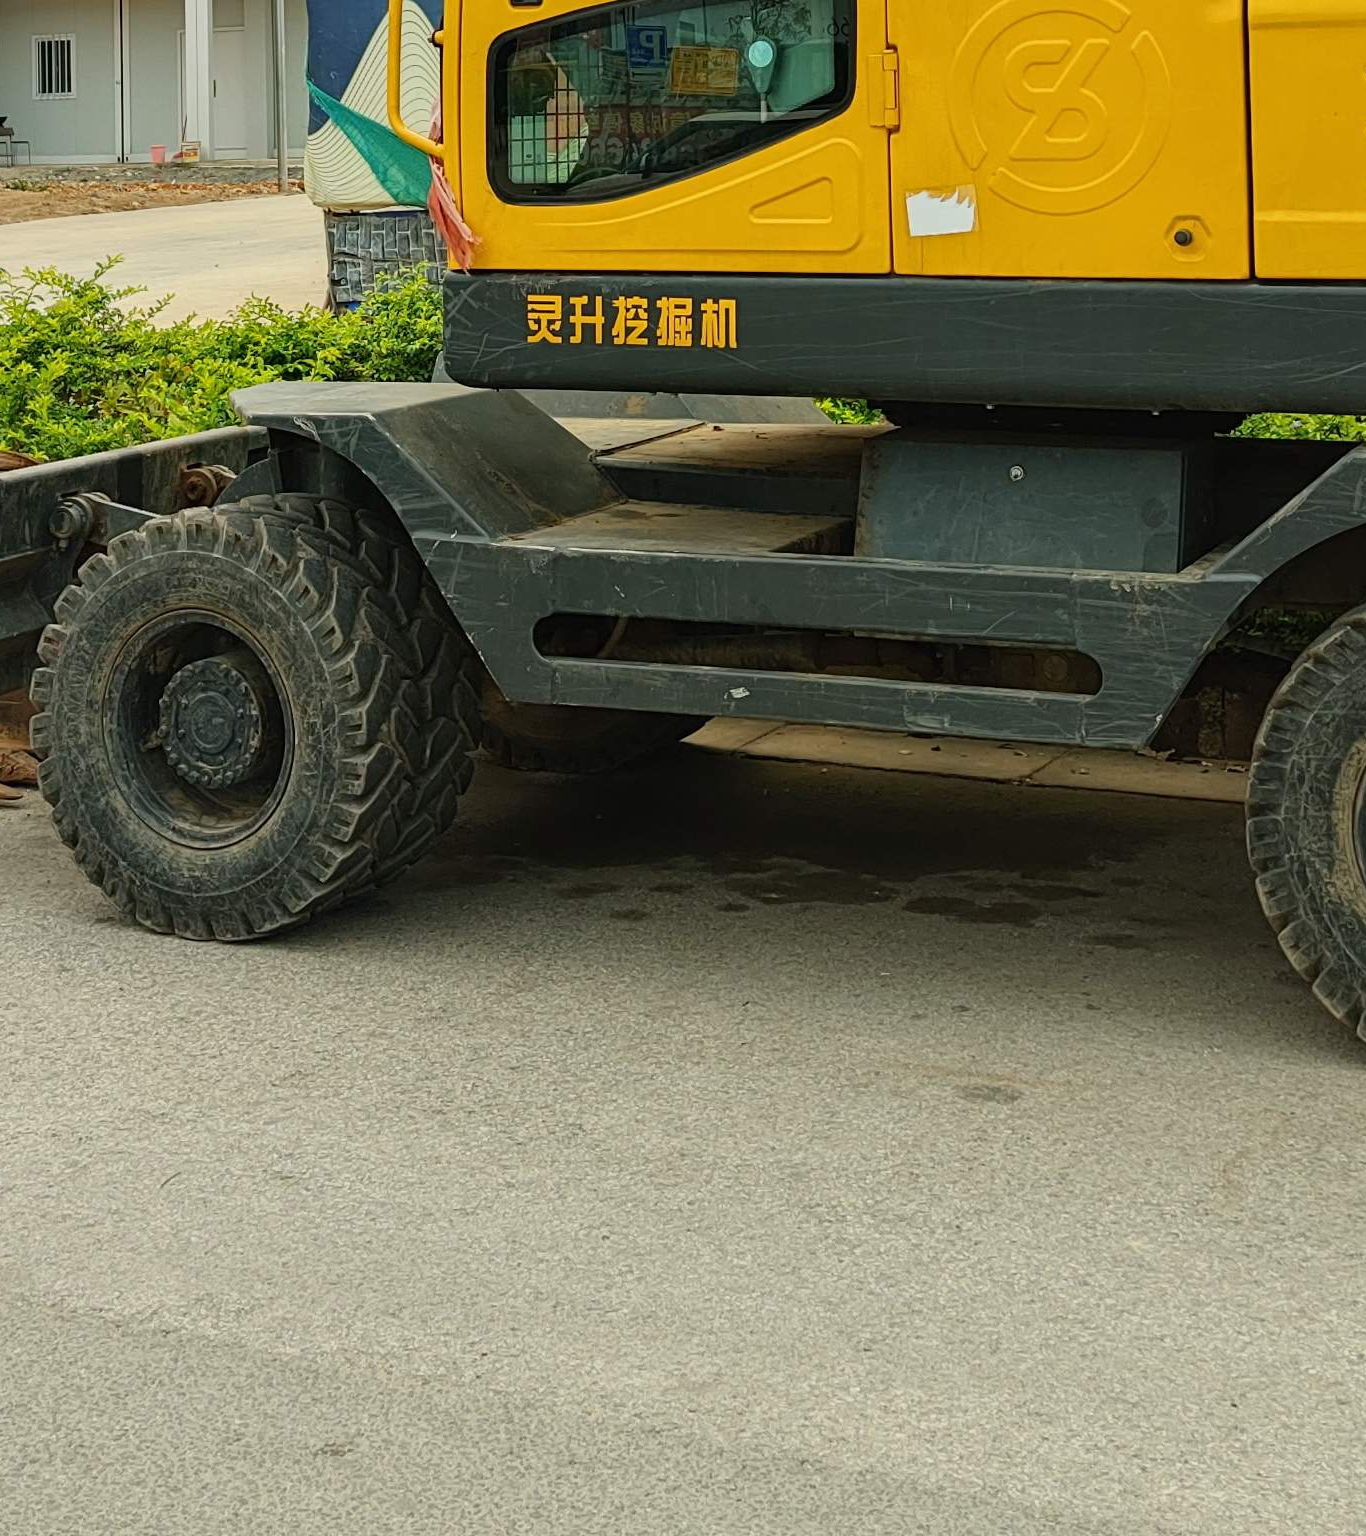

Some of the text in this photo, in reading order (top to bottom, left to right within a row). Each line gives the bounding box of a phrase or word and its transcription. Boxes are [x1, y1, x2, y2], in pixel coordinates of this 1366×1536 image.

[527, 294, 737, 348] 灵升挖掘机
